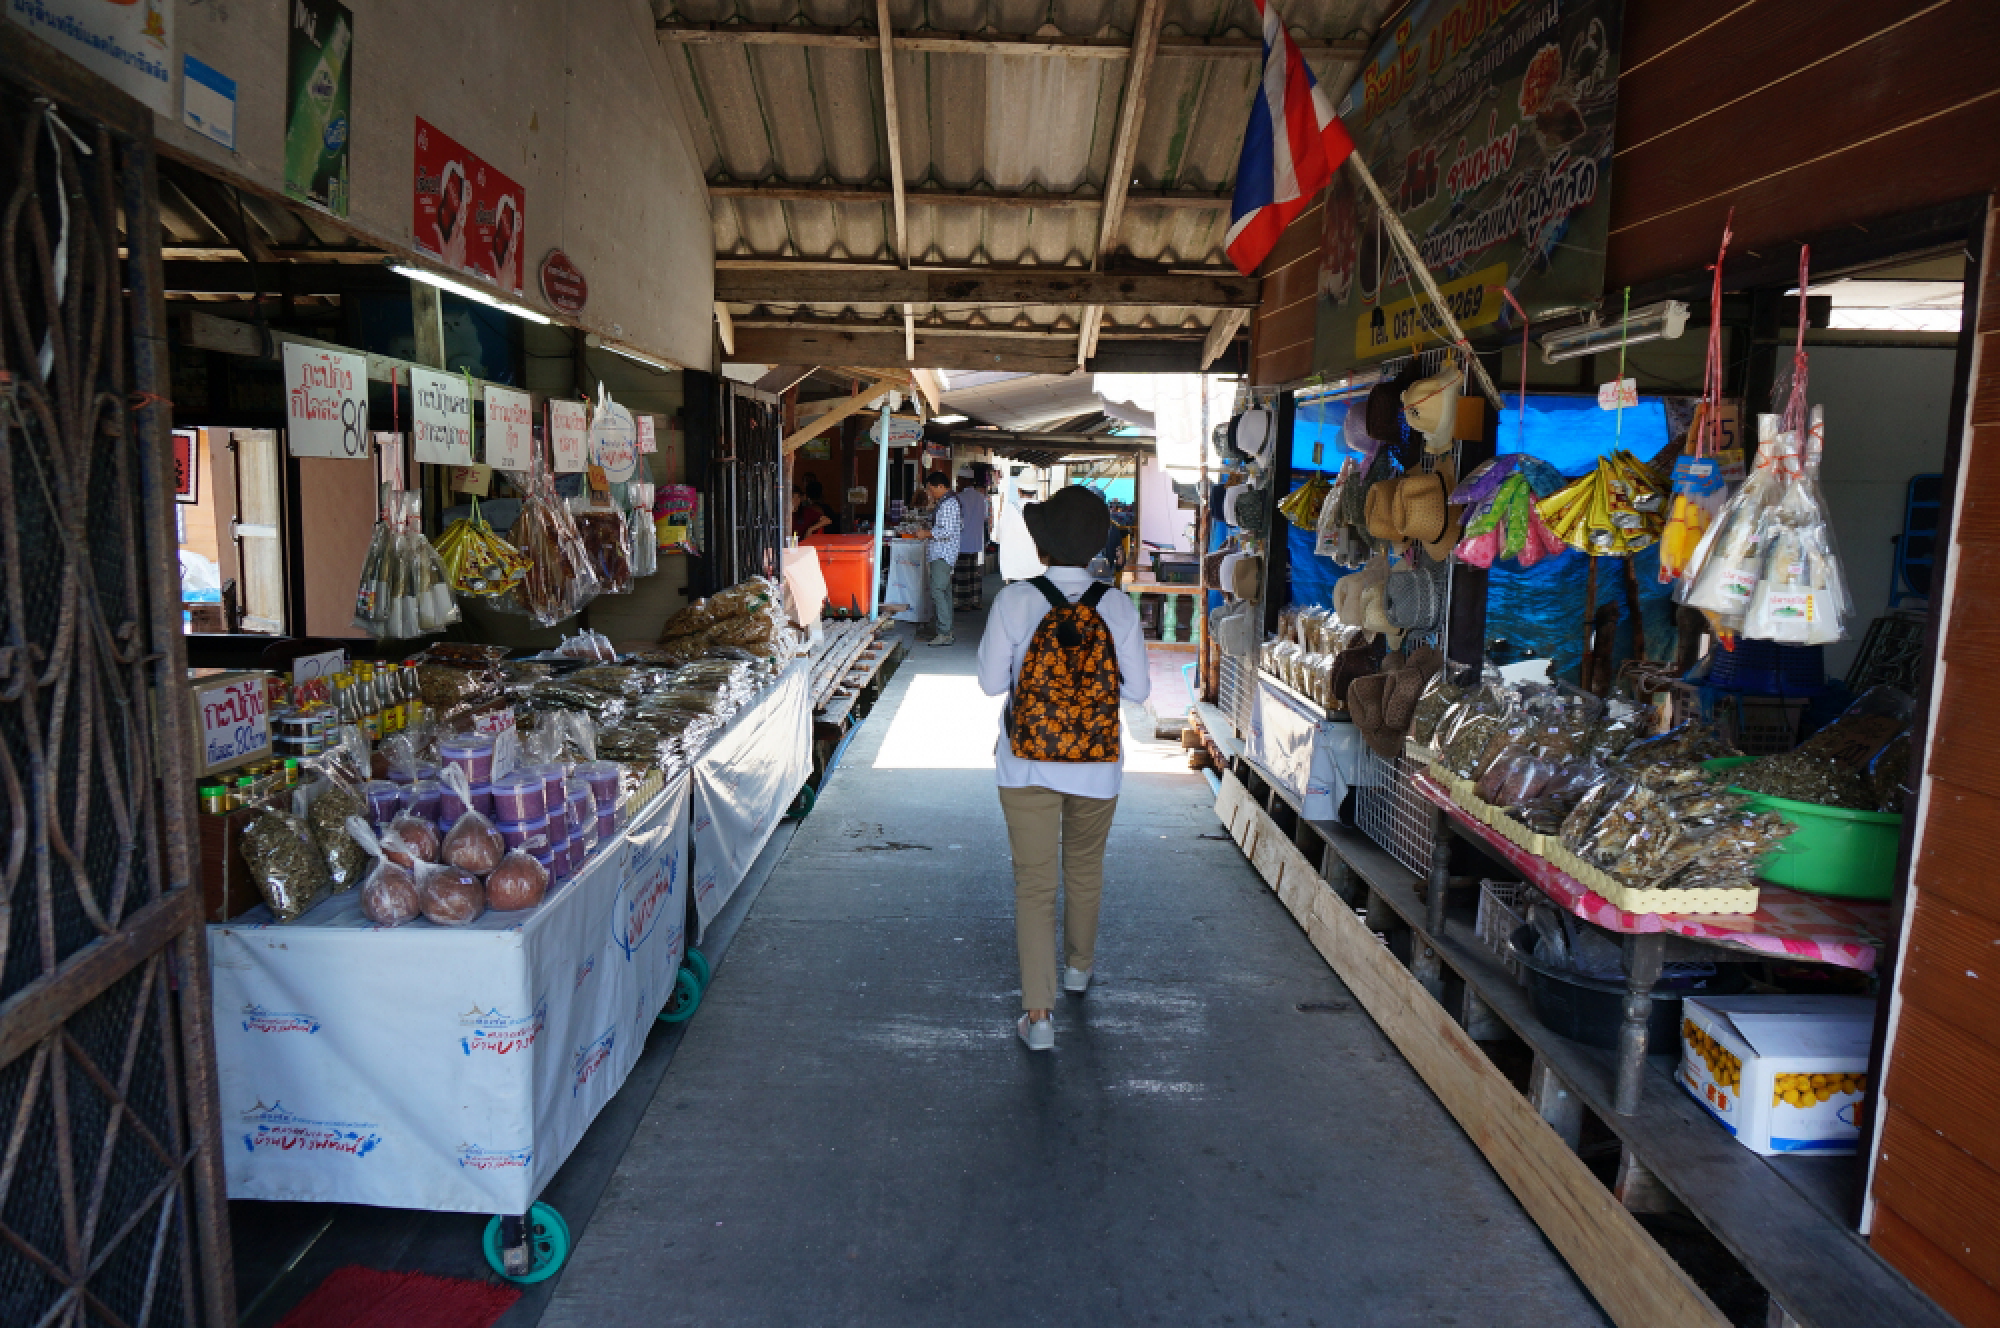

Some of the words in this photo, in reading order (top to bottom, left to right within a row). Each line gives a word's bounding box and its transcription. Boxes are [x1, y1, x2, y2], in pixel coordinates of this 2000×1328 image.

[14, 0, 169, 83] มจุลินทรีย์แลคโตบาซิลลัส
[1446, 108, 1518, 200] จำหน่าย
[1394, 284, 1484, 341] 087-88269
[342, 398, 368, 457] 80
[203, 681, 265, 730] กะปิกุ้ง
